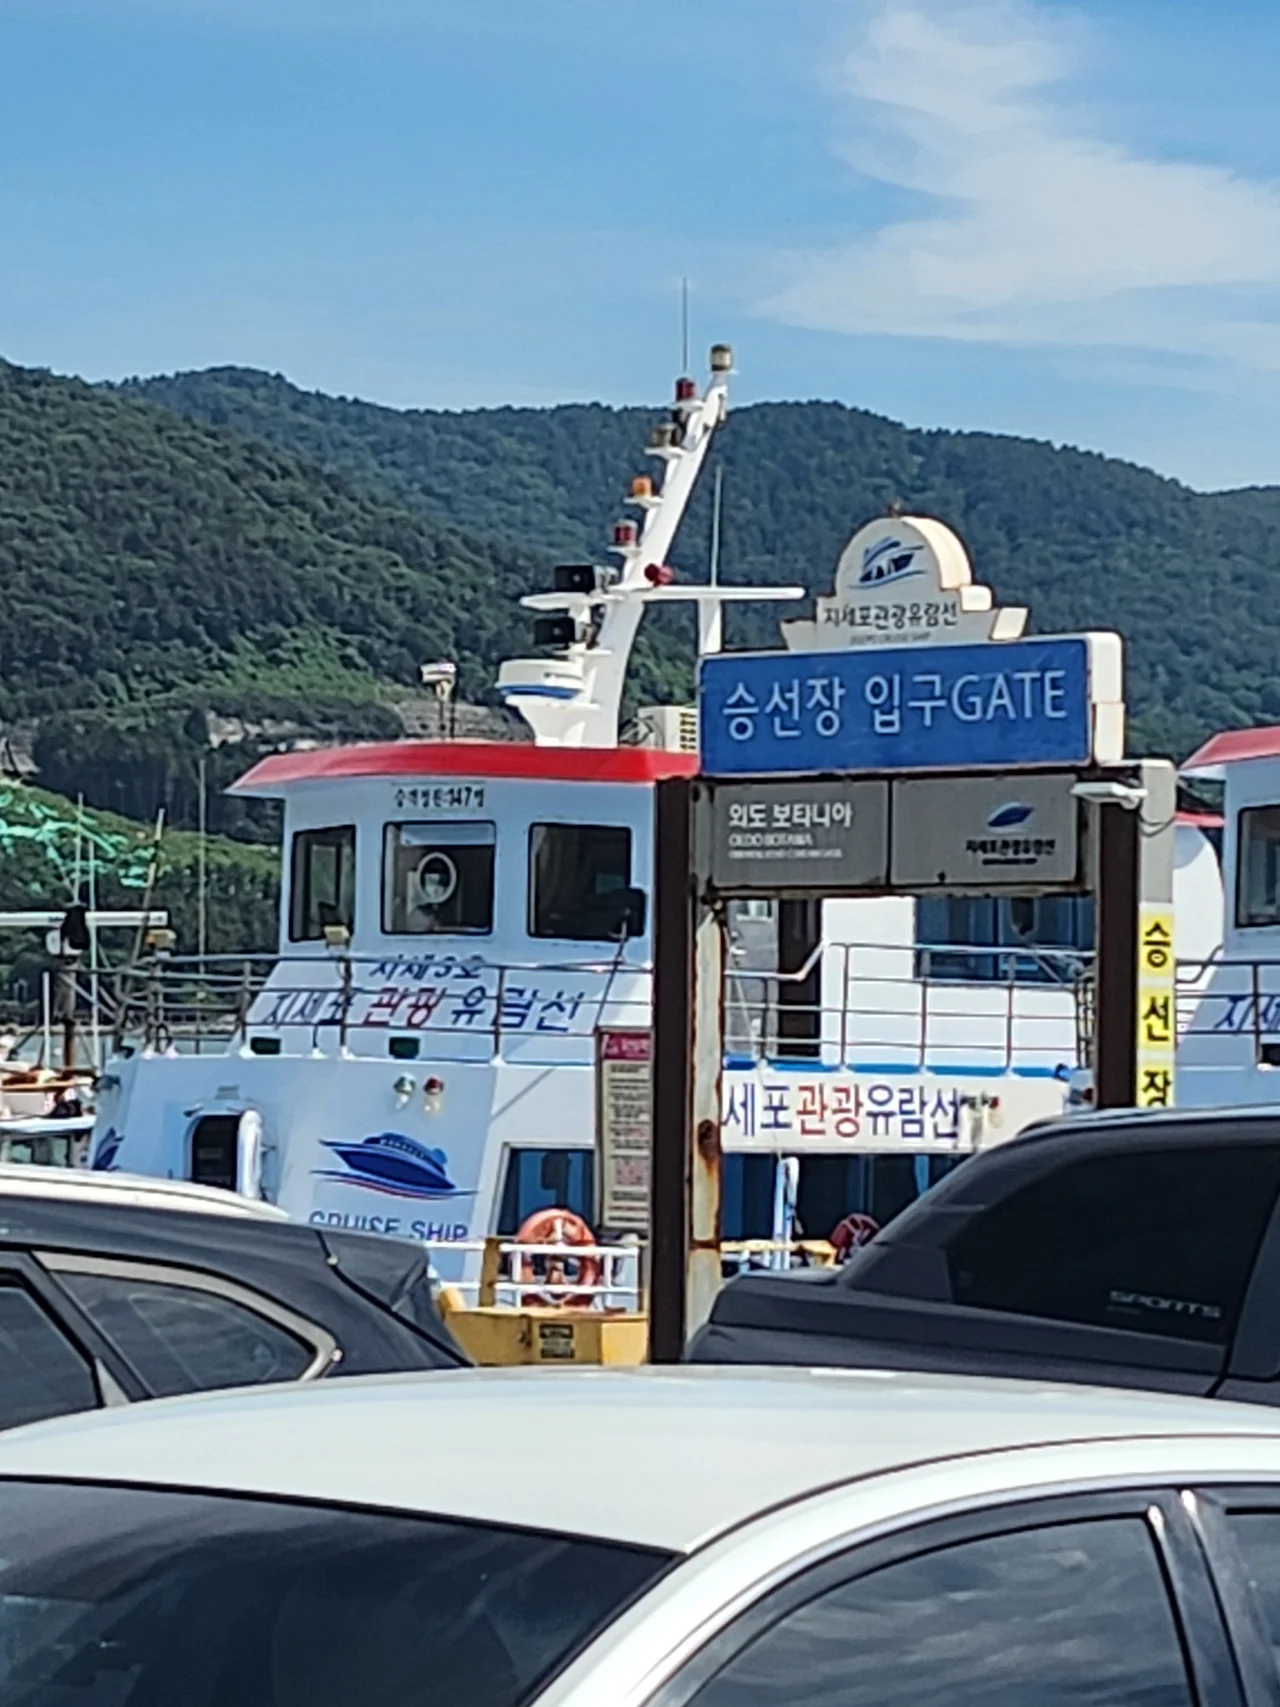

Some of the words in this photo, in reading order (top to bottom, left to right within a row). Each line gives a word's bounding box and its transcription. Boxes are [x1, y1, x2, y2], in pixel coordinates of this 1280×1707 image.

[824, 601, 958, 630] 지세포관광유람선
[722, 676, 846, 741] 승선장
[729, 803, 766, 828] 외도
[772, 801, 852, 828] 보타니아
[410, 1220, 469, 1243] SHIP
